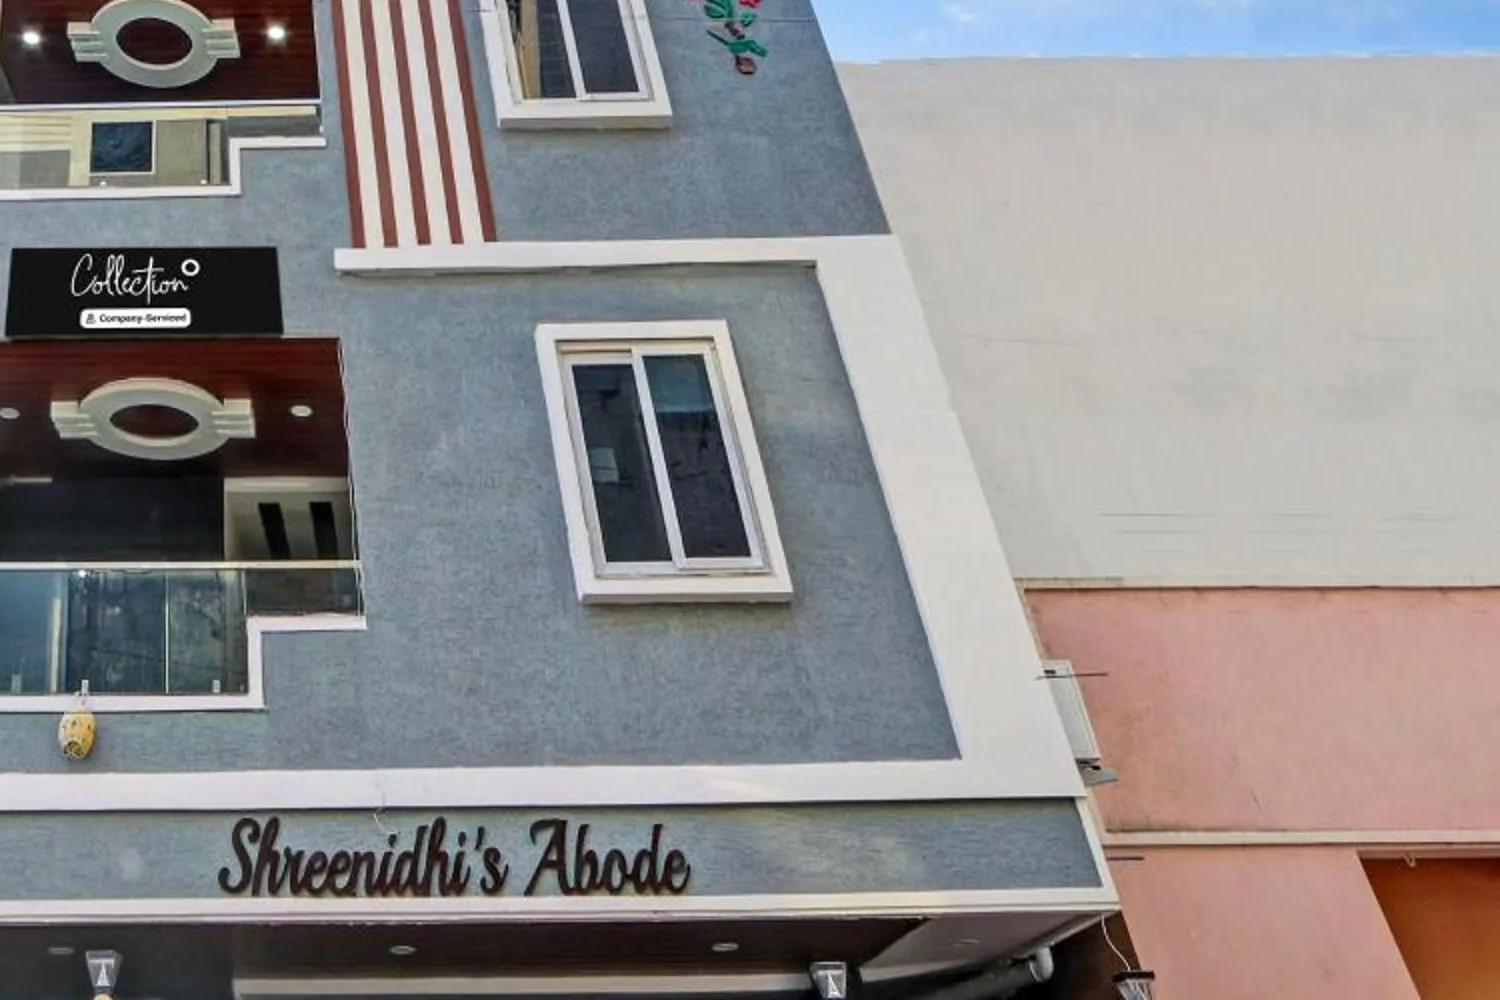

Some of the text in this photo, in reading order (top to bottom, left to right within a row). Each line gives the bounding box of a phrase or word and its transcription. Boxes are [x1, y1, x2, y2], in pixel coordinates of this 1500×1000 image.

[71, 253, 189, 305] Collection
[218, 817, 691, 897] Shreenidhi's Abode
